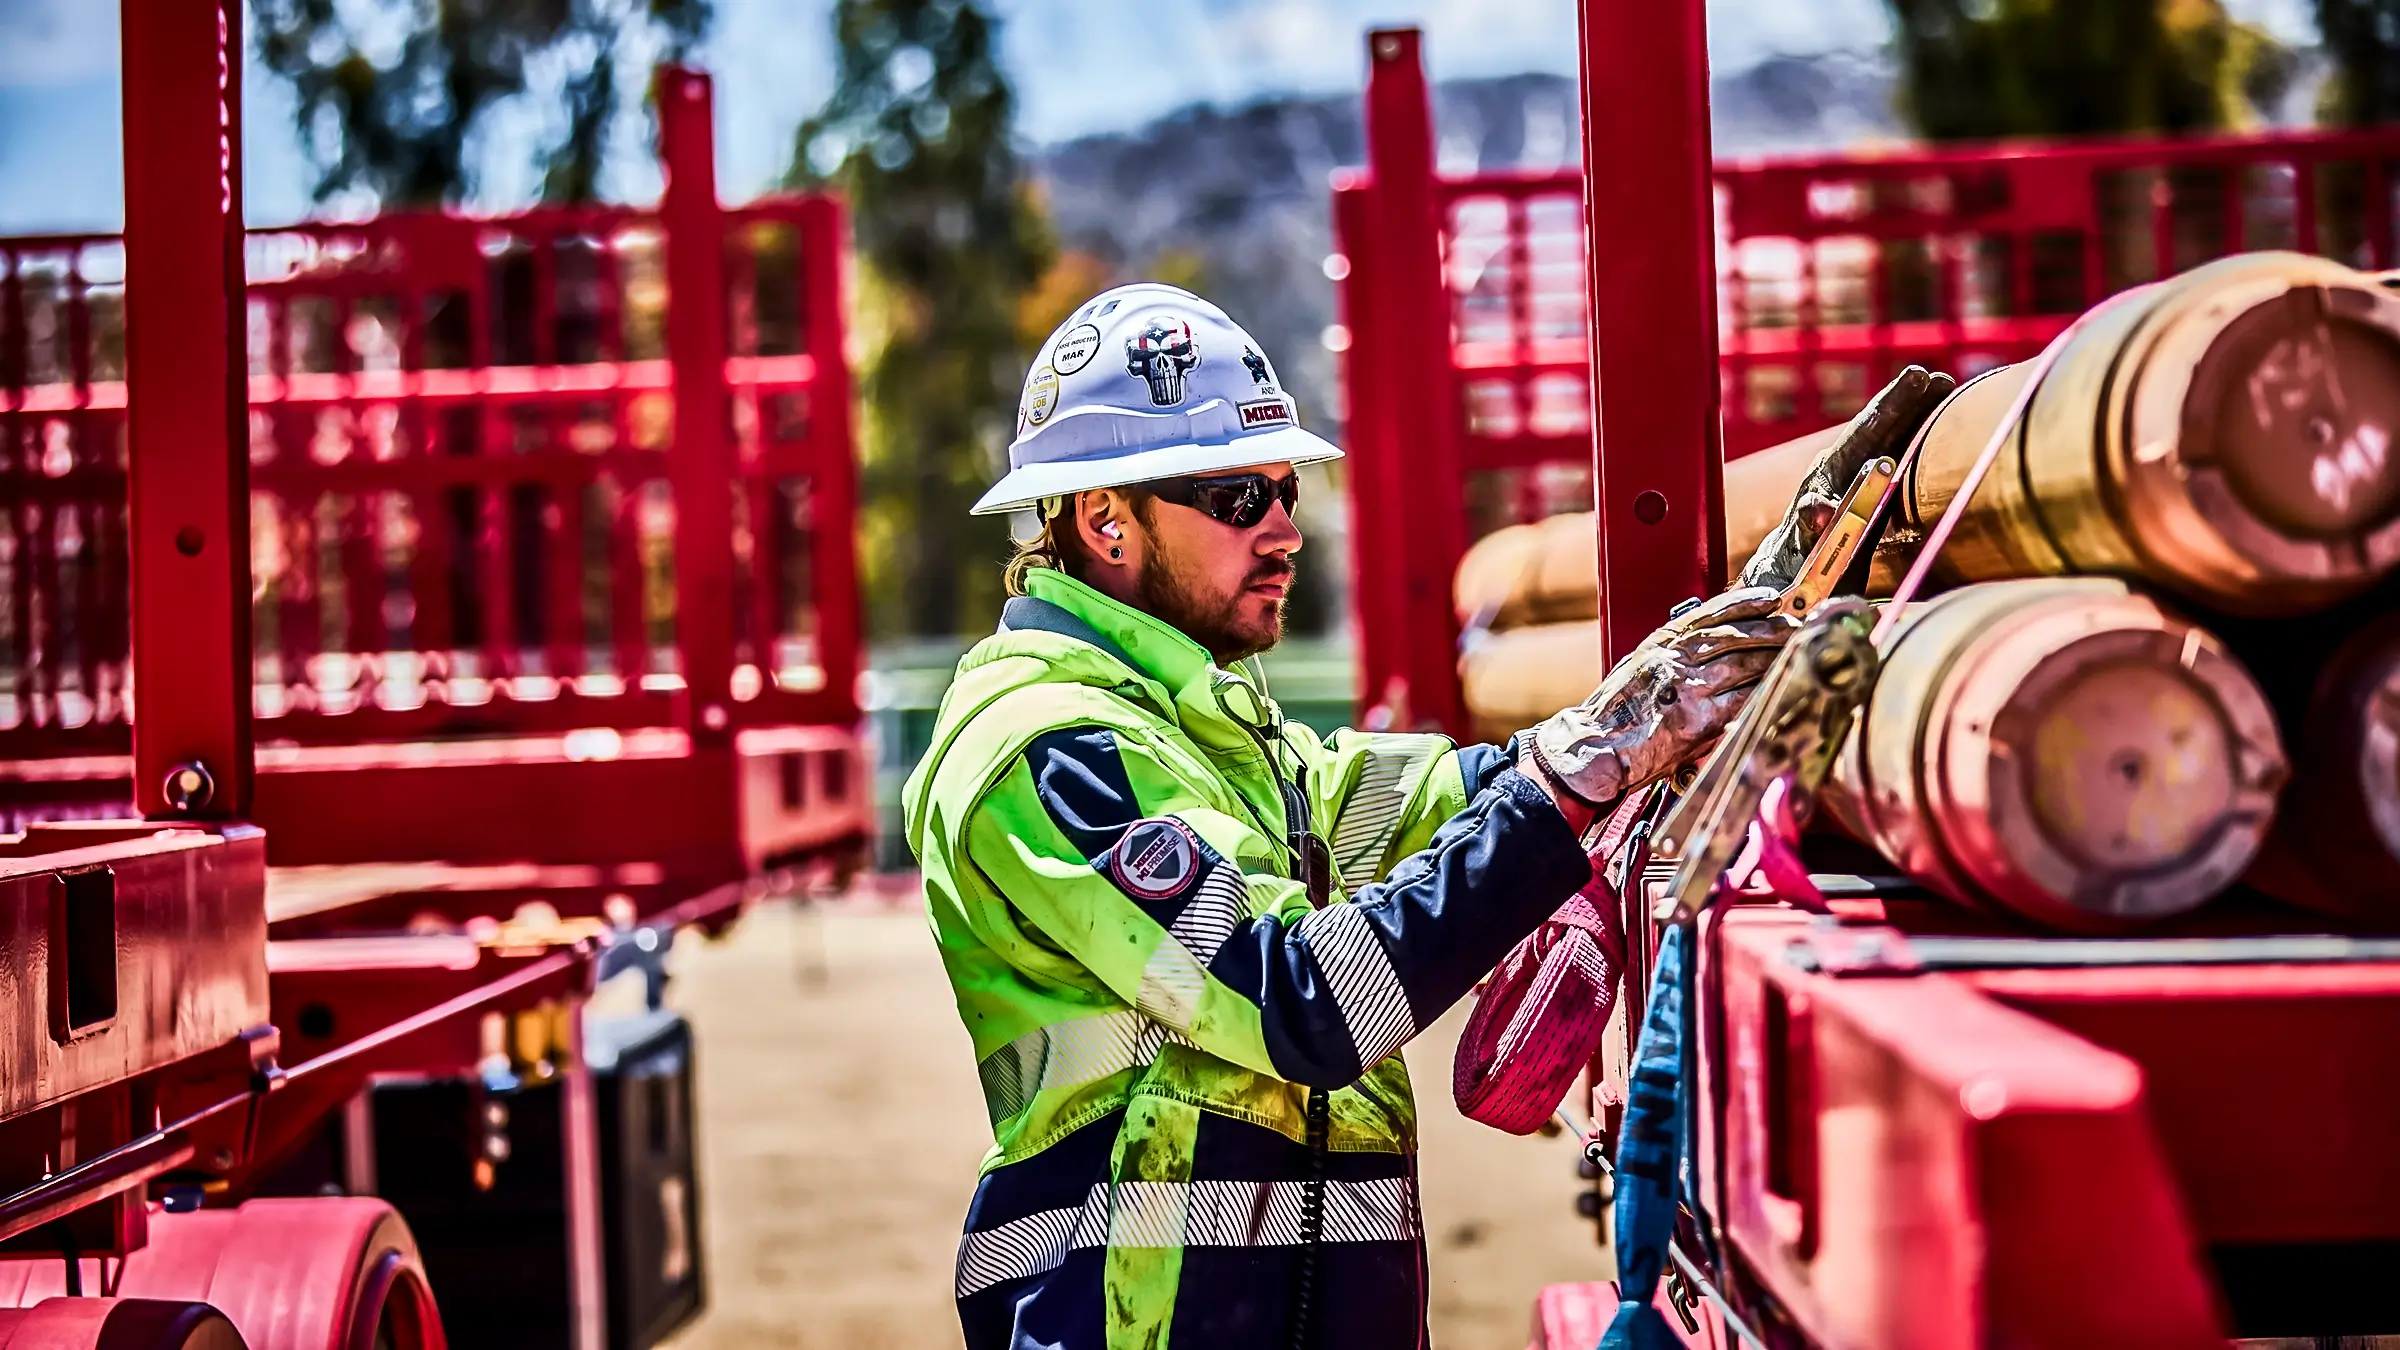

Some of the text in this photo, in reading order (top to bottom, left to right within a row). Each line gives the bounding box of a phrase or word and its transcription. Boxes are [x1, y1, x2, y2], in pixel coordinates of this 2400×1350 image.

[1062, 350, 1084, 361] MAR
[1032, 399, 1047, 409] LOB
[1133, 835, 1166, 871] MICHELS
[1136, 835, 1180, 881] MI-PROMISE
